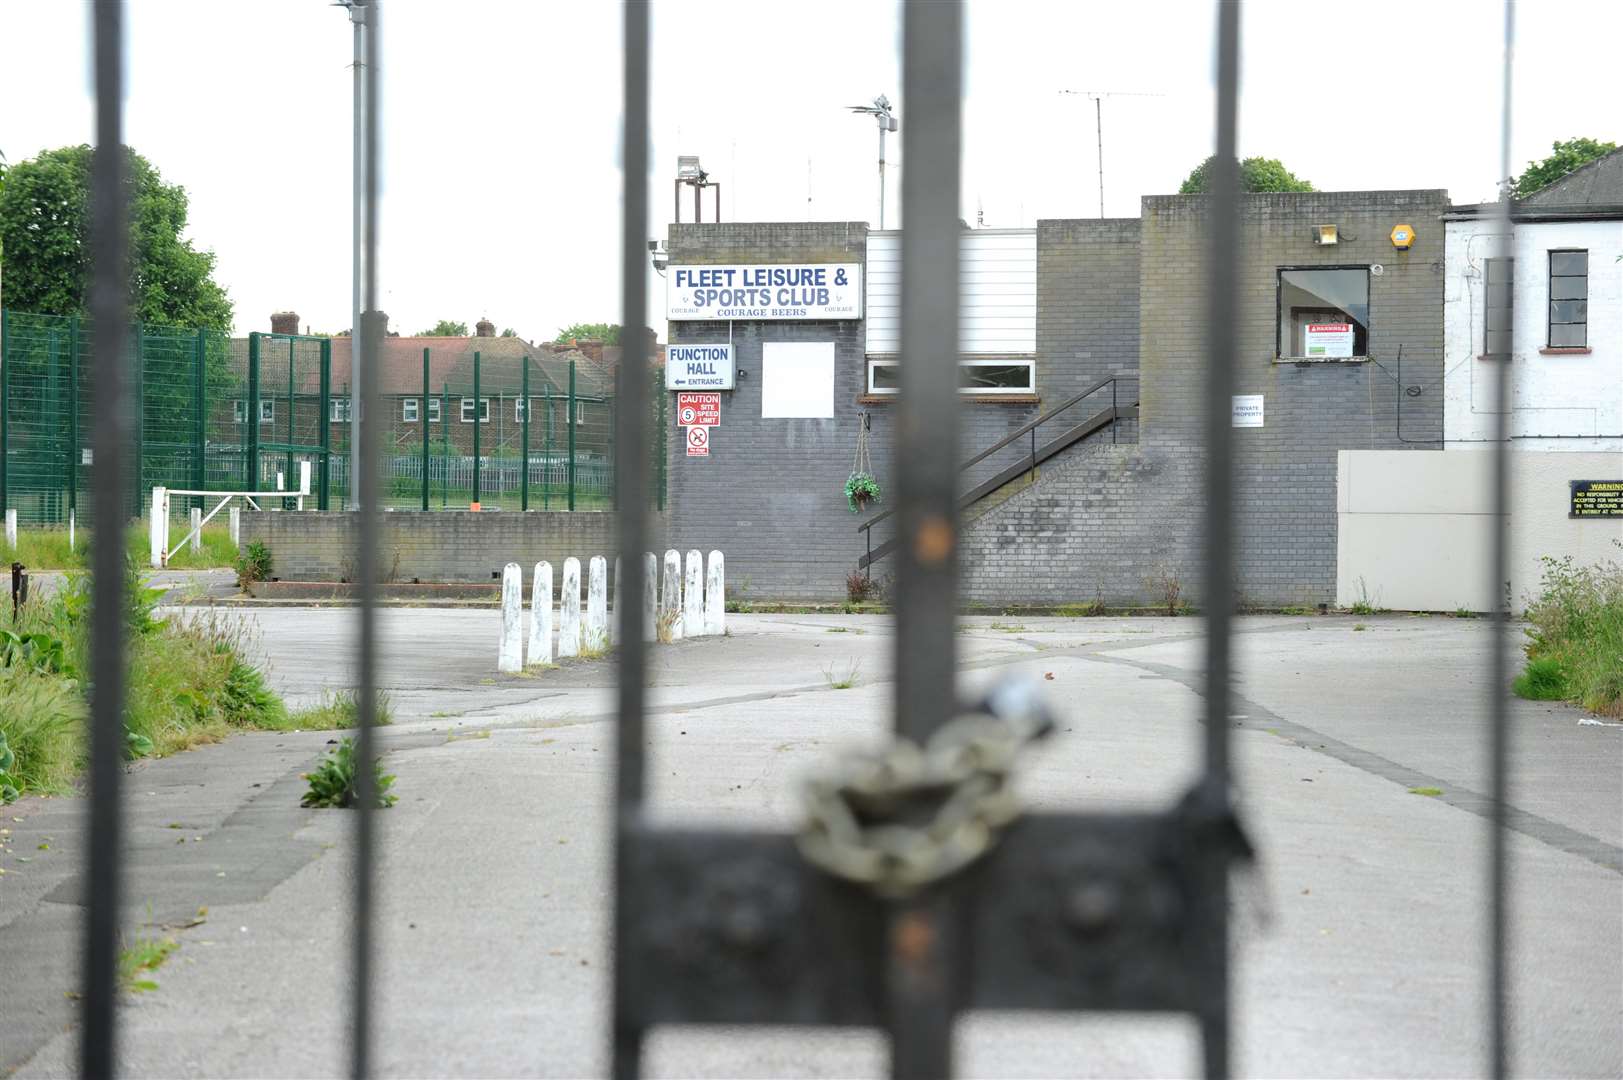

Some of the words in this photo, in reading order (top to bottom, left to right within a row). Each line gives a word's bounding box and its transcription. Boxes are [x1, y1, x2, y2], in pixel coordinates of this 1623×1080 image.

[675, 269, 736, 287] FLEET
[743, 268, 826, 287] LEISURE
[834, 267, 848, 286] &
[693, 288, 771, 307] SPORTS
[776, 288, 830, 306] CLUB
[717, 309, 767, 317] COURAGE
[772, 308, 806, 316] BEERS
[670, 348, 728, 361] FUNCTION
[687, 363, 717, 375] HALL
[680, 395, 719, 404] CAUTION
[685, 410, 691, 419] 5
